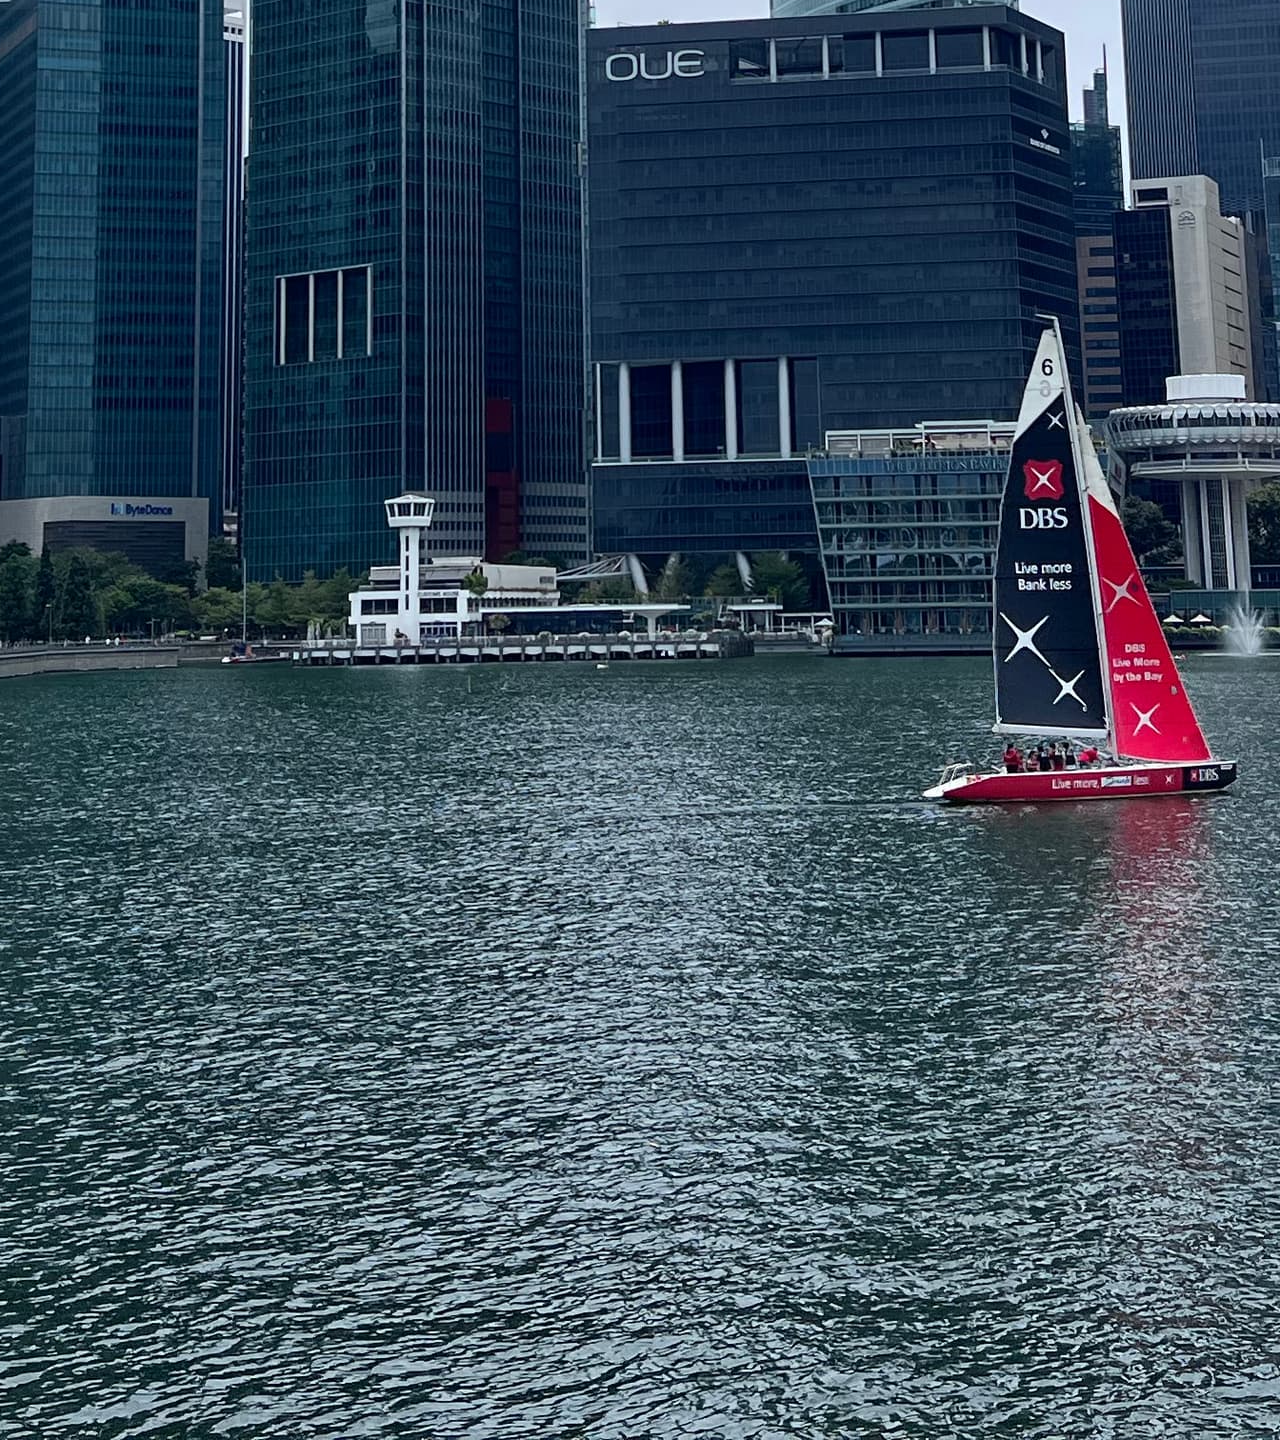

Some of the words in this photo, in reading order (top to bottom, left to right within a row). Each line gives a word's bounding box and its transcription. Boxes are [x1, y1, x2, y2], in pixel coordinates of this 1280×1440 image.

[606, 50, 705, 81] OUE
[1041, 358, 1053, 376] 6
[1019, 507, 1069, 529] DBS
[1015, 562, 1038, 574] Live
[1041, 563, 1073, 574] more
[1018, 578, 1047, 591] Bank
[1049, 578, 1073, 591] less
[1125, 643, 1146, 653] DBS
[1112, 658, 1131, 668] Live
[1133, 657, 1161, 667] More
[1113, 672, 1124, 683] by
[1125, 672, 1142, 681] the
[1144, 671, 1164, 683] Bay
[1199, 768, 1220, 781] DBS
[1052, 778, 1072, 789] Live
